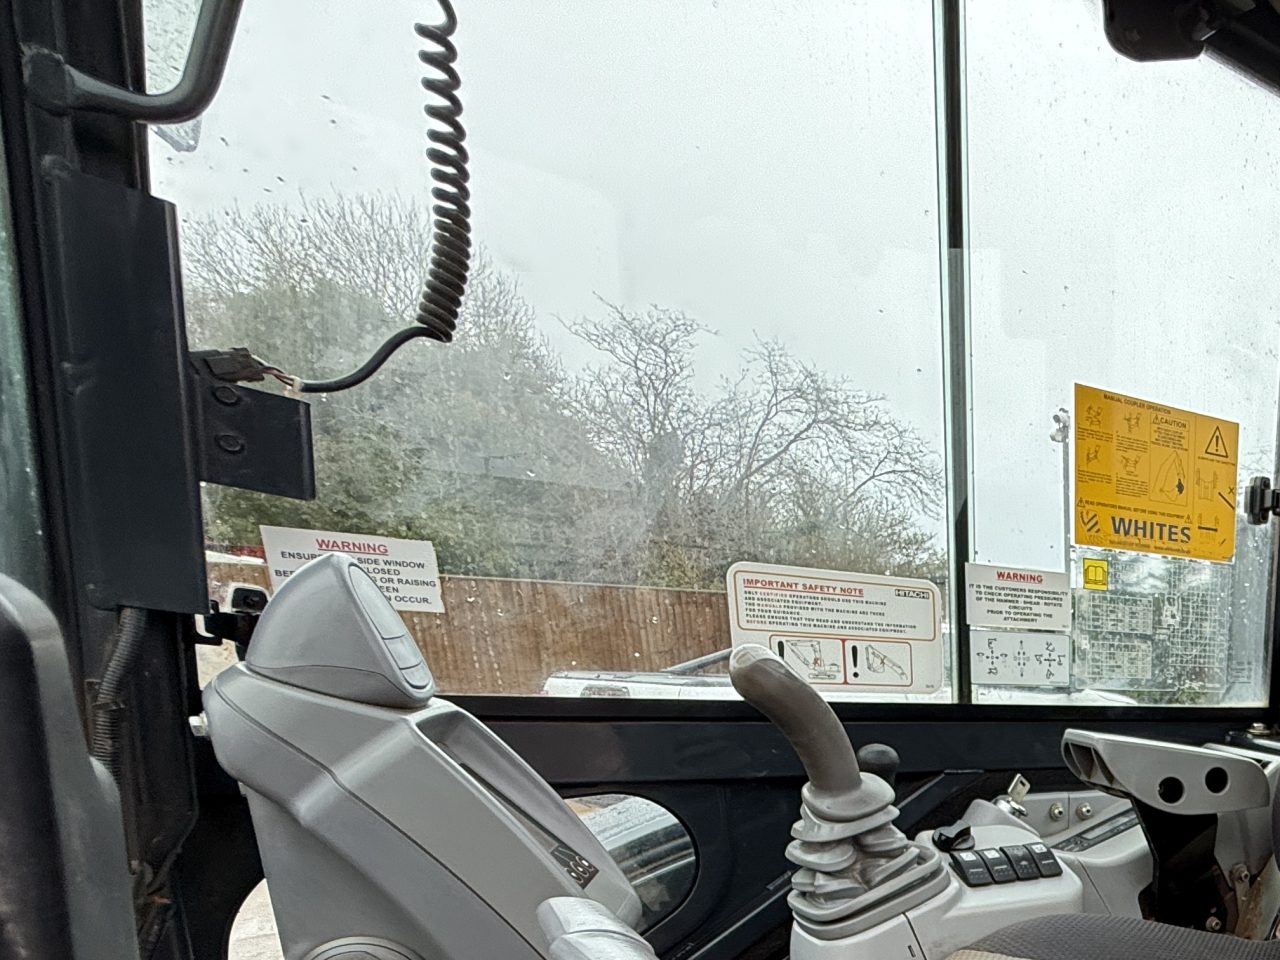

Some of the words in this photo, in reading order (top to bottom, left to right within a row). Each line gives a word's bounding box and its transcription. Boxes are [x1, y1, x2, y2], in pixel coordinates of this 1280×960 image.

[1160, 417, 1186, 429] CAUTION
[1110, 516, 1191, 544] WHITES
[316, 539, 389, 554] WARNING
[357, 558, 380, 566] SIDE
[382, 560, 424, 569] WINDOW
[996, 570, 1043, 583] WARNING
[398, 579, 436, 588] RAISING
[742, 578, 799, 590] IMPORTANT
[802, 584, 837, 592] SAFETY
[840, 587, 864, 595] NOTE
[896, 590, 929, 599] HITACHI
[394, 595, 432, 604] OCCUR.
